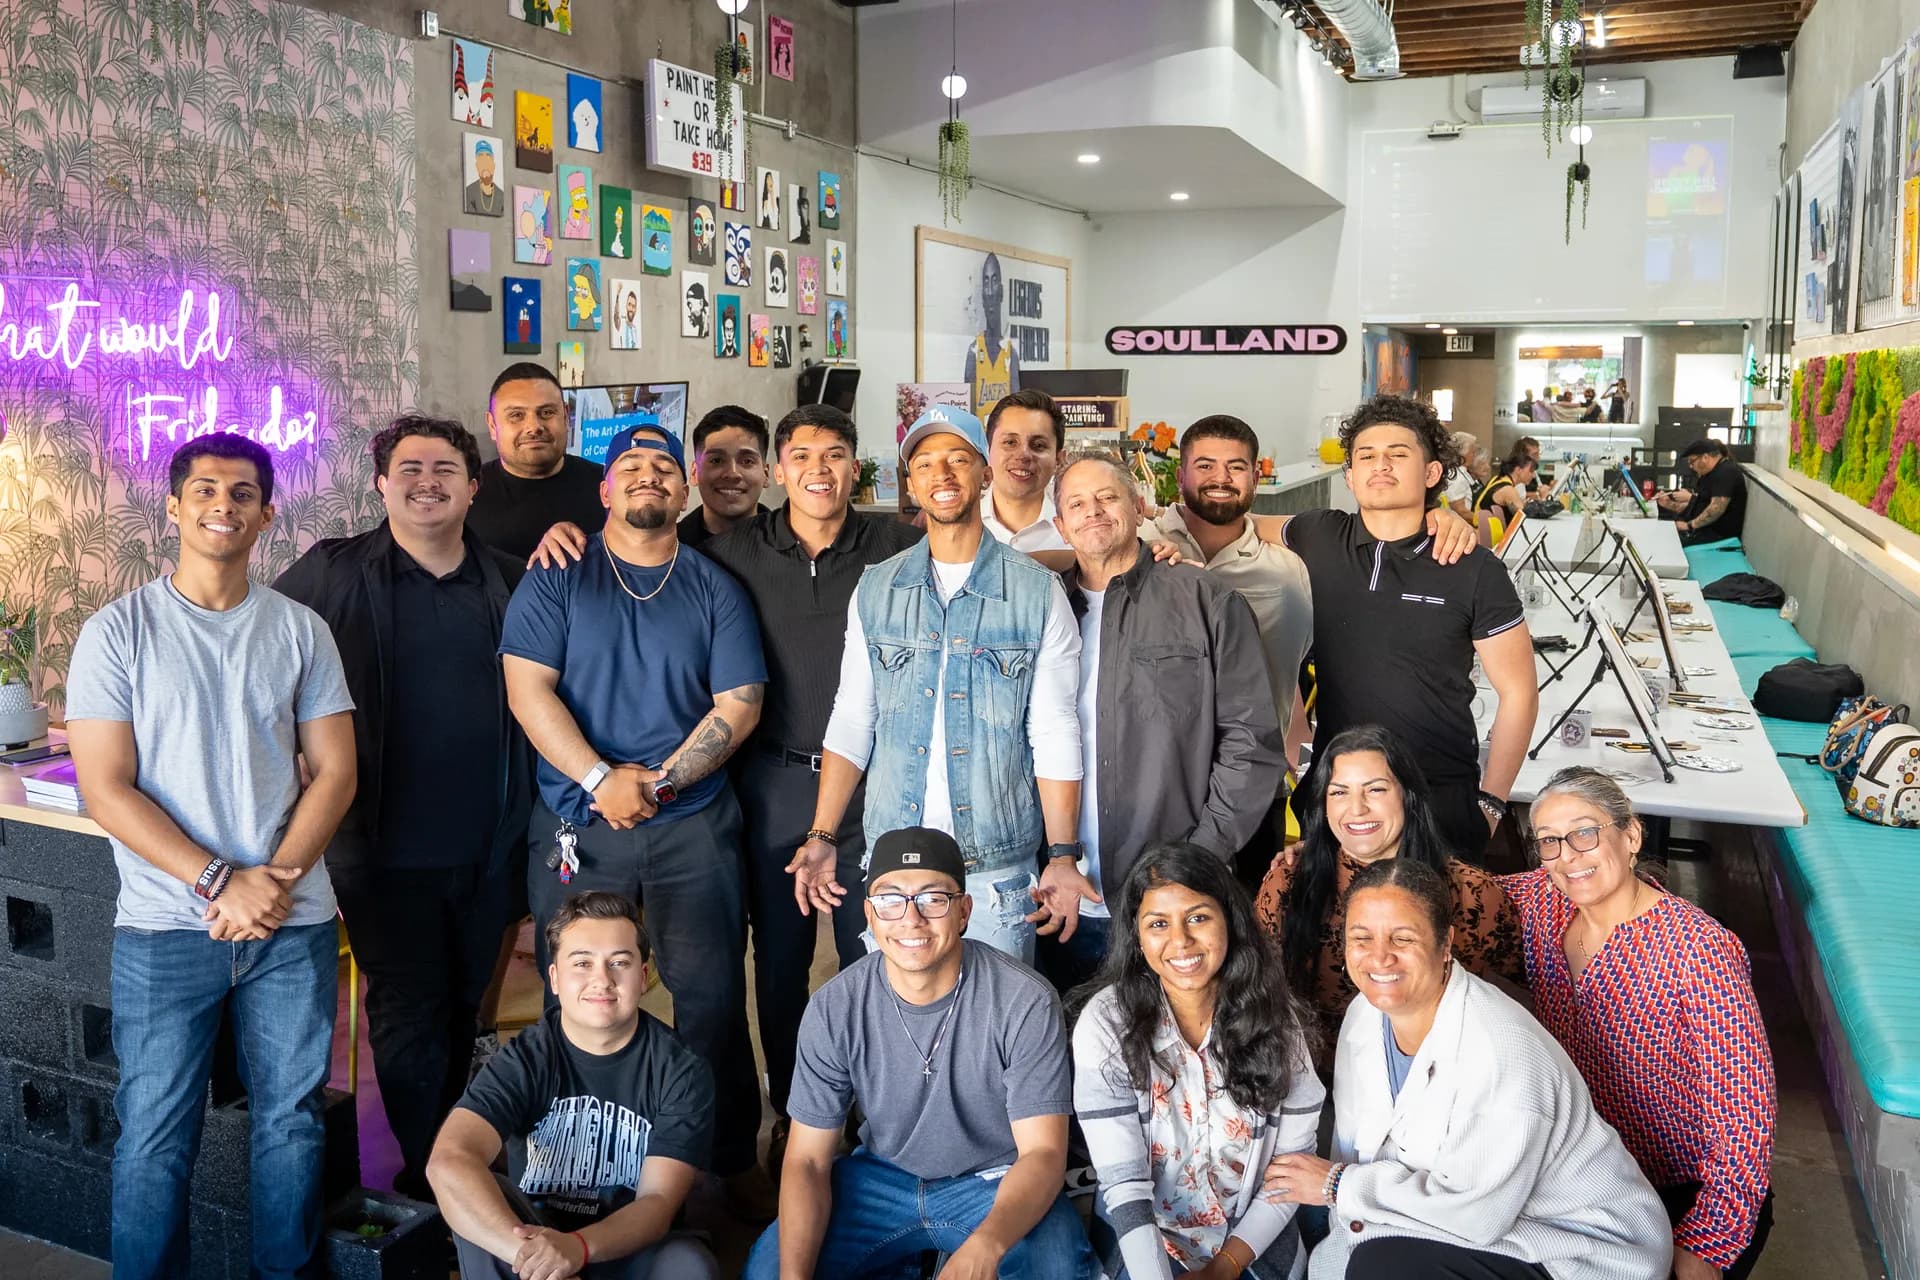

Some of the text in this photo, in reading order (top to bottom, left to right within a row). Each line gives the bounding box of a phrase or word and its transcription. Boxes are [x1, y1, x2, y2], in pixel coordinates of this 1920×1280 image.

[667, 67, 716, 101] PAINT HE
[694, 101, 709, 123] OR
[673, 120, 700, 146] TAKE
[691, 151, 712, 172] $39
[0, 282, 234, 370] hat would
[1111, 328, 1338, 351] SOULLAND
[1451, 336, 1470, 350] EXIT
[585, 427, 600, 438] The
[601, 424, 613, 436] Art
[583, 445, 593, 457] of
[198, 858, 226, 886] esus
